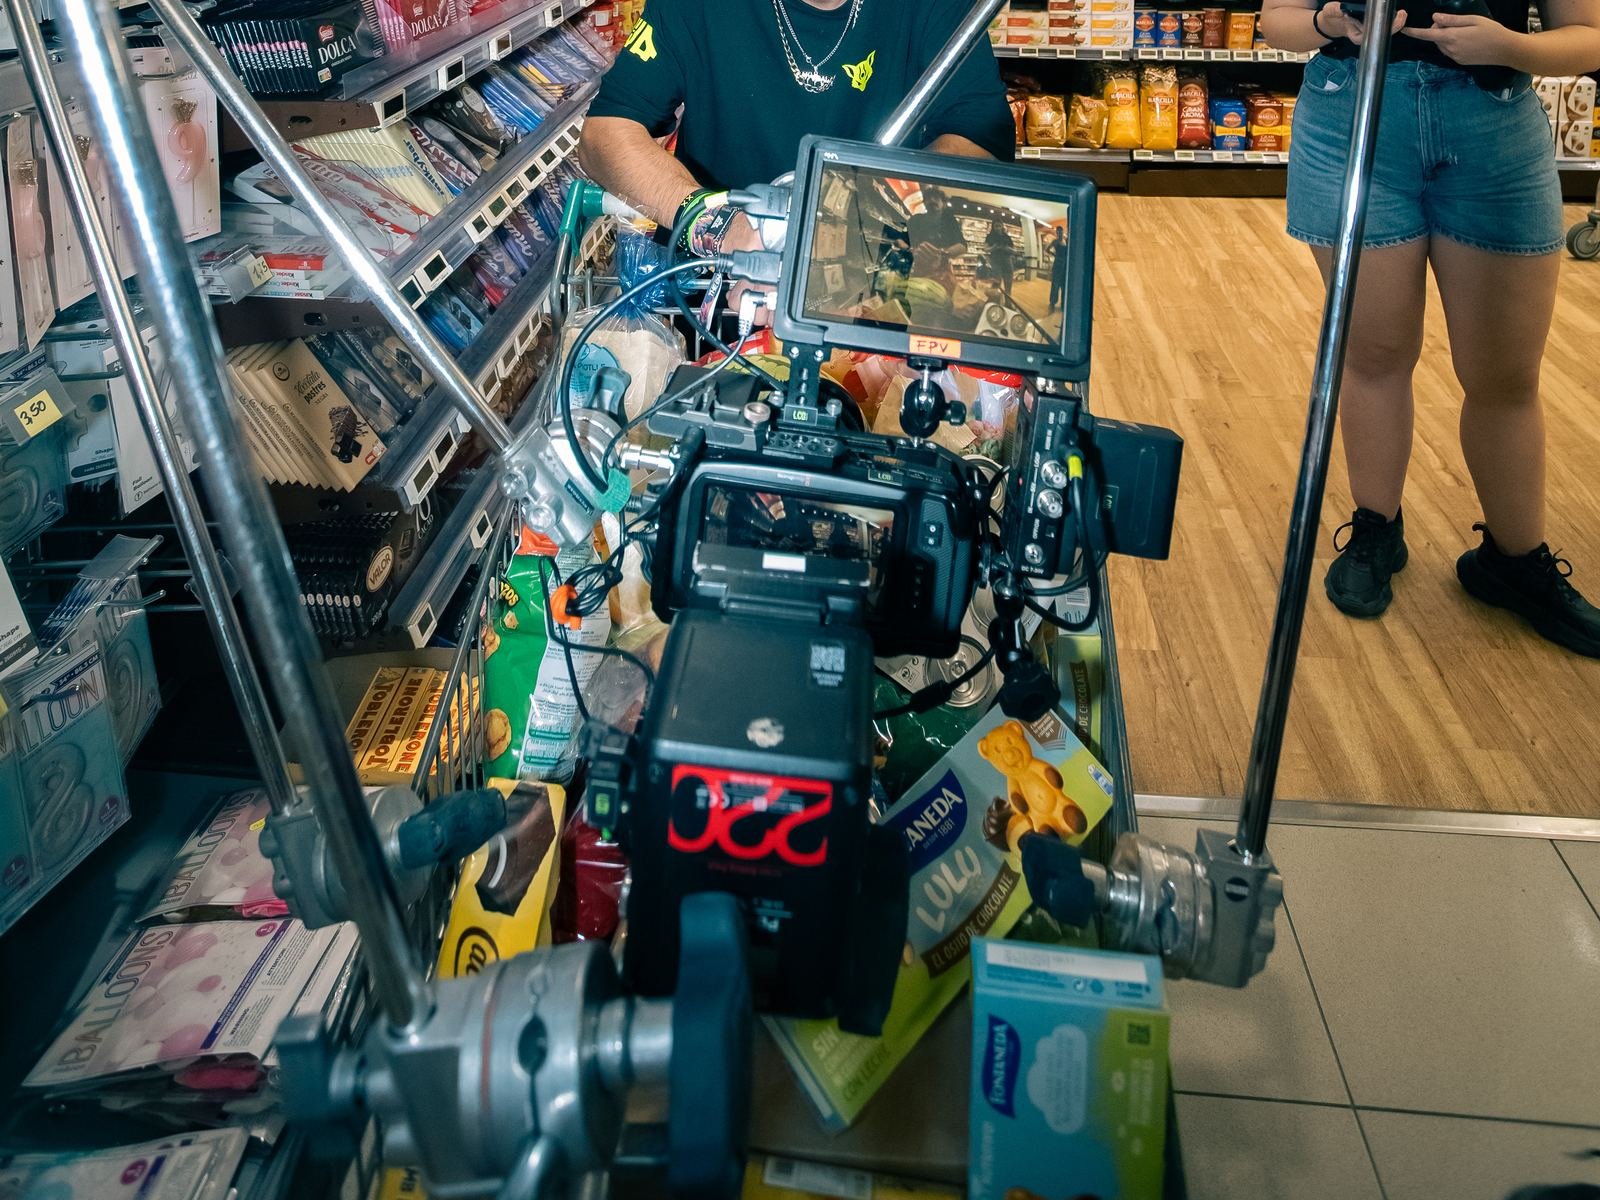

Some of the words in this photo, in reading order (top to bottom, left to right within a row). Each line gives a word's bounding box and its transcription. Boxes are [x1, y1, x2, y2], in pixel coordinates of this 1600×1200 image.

[411, 14, 439, 37] DOLCA
[317, 35, 357, 65] DOLCA
[915, 340, 949, 354] FPV
[303, 380, 327, 404] postres
[19, 400, 47, 426] 3,50
[369, 554, 392, 586] VALOR
[350, 681, 394, 752] TOBLERO
[366, 677, 424, 767] TOBLERONE
[906, 784, 964, 853] ANEDA
[937, 817, 957, 838] 1881
[915, 845, 984, 934] LULU
[976, 874, 1014, 931] CHOCOLATE
[66, 929, 175, 1070] BALLOONS
